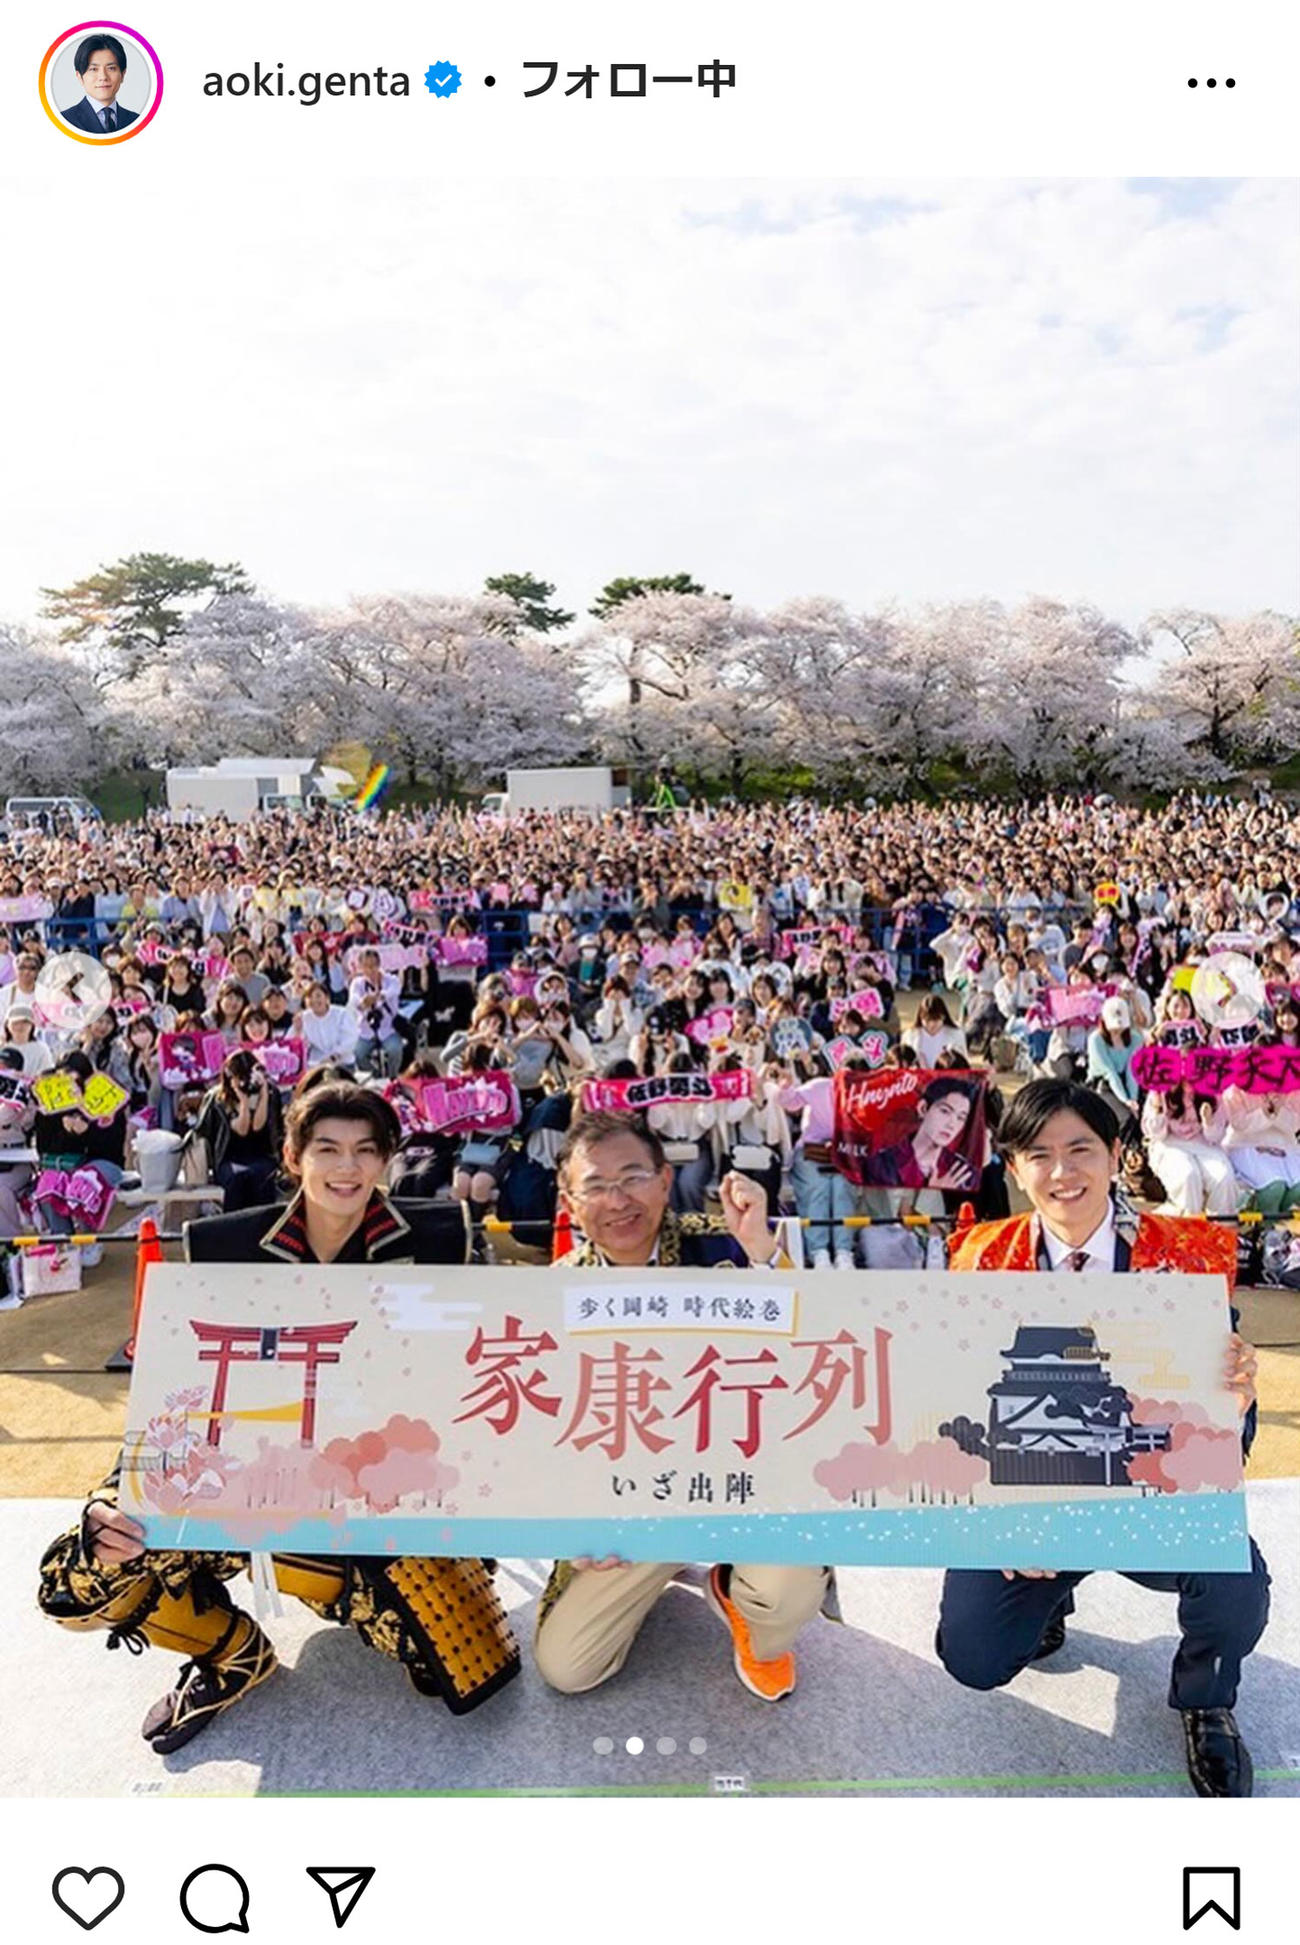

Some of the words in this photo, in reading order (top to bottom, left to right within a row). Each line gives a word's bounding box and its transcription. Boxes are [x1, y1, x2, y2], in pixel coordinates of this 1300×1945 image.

[579, 1296, 668, 1319] 歩く岡崎
[683, 1295, 782, 1323] 時代絵巻
[451, 1315, 894, 1461] 家康行列
[612, 1469, 756, 1505] いざ出陣
